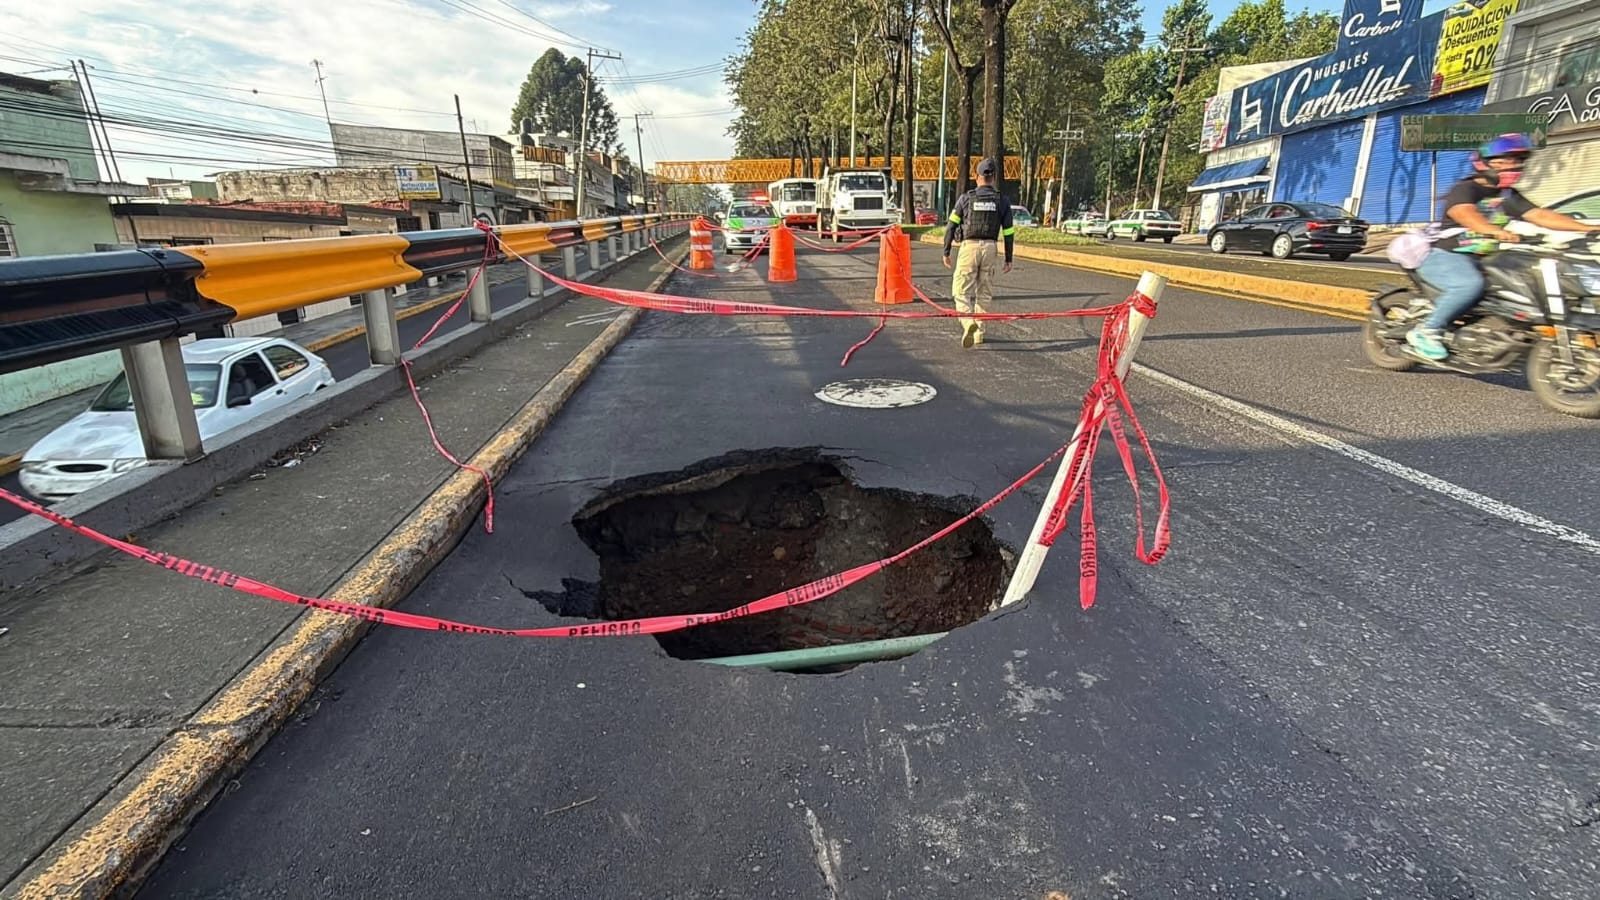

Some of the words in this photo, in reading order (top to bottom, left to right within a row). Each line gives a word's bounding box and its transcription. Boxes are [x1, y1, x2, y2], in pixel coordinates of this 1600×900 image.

[1445, 25, 1499, 50] Descuentos
[1314, 52, 1369, 81] MUEBLES
[1280, 55, 1415, 128] Carballal
[1580, 107, 1600, 122] CO
